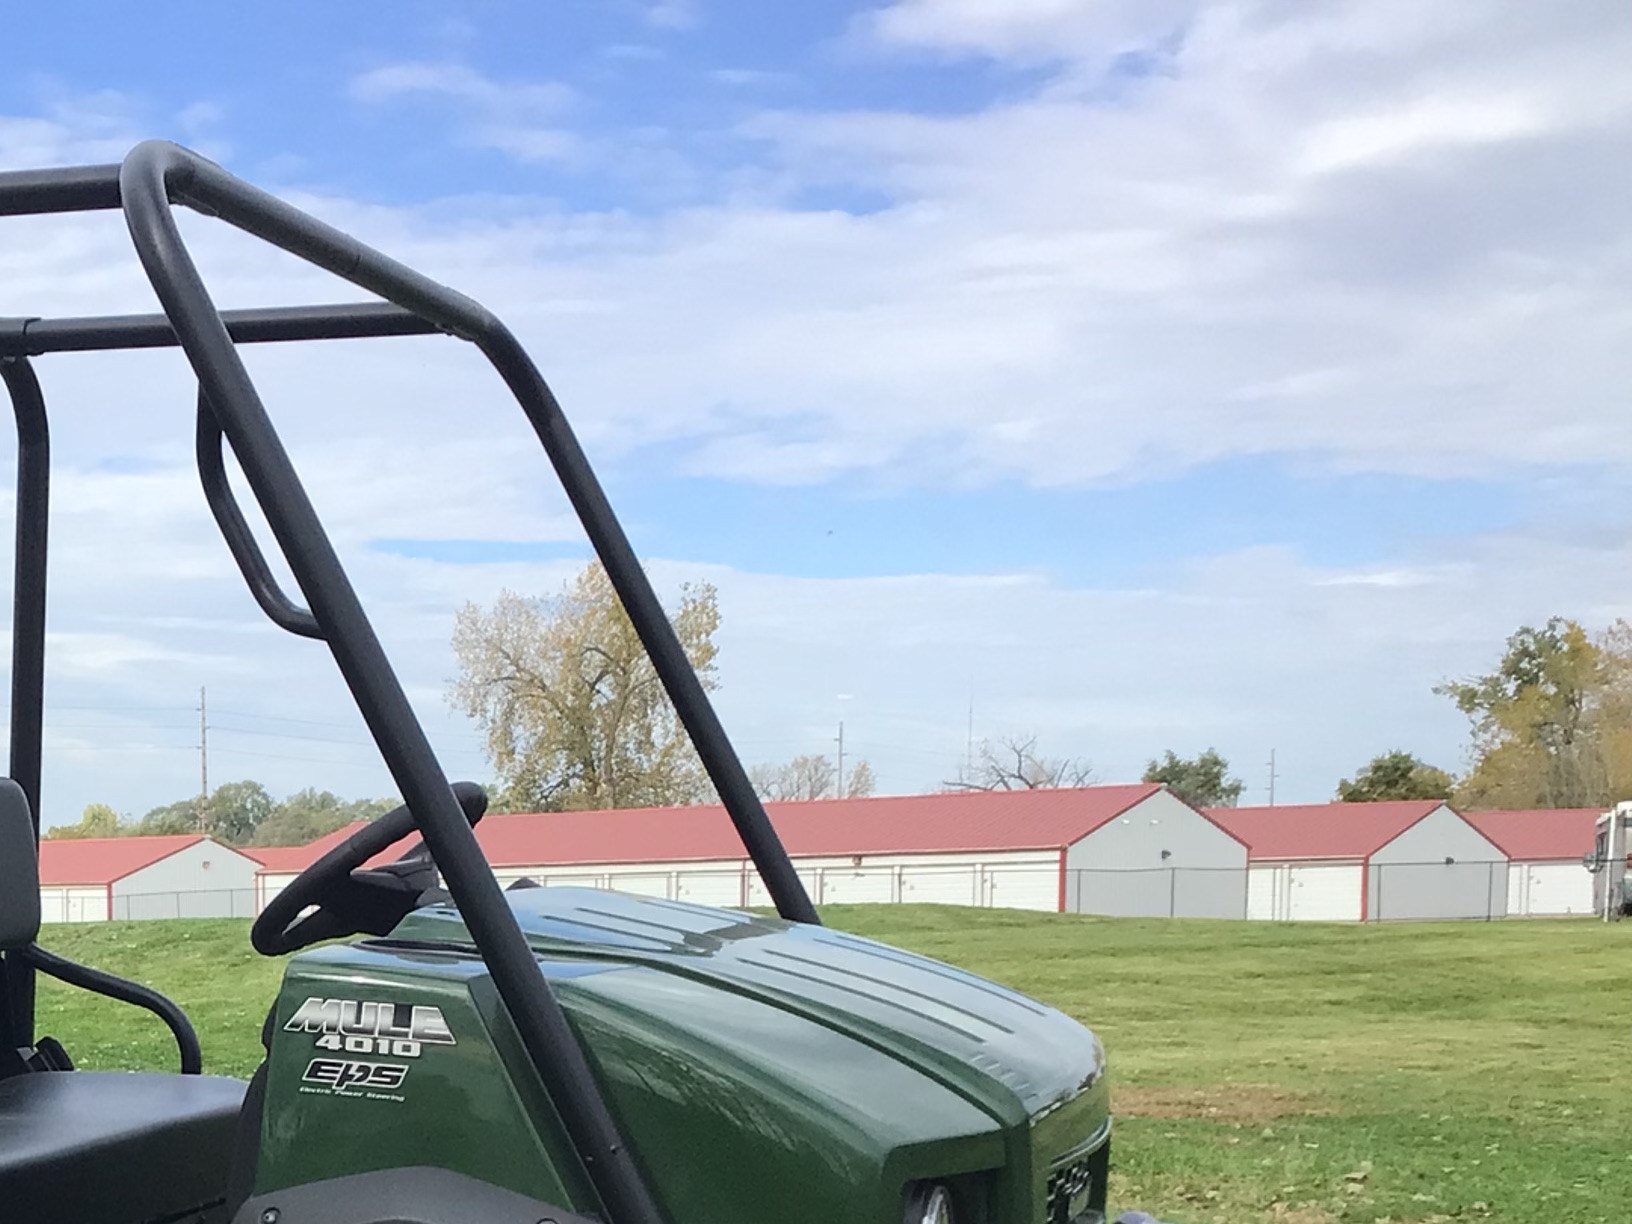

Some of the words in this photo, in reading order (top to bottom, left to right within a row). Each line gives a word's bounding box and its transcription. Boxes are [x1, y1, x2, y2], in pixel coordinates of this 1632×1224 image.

[283, 997, 456, 1044] MULE
[315, 1034, 421, 1057] 4010
[302, 1058, 409, 1089] EPS
